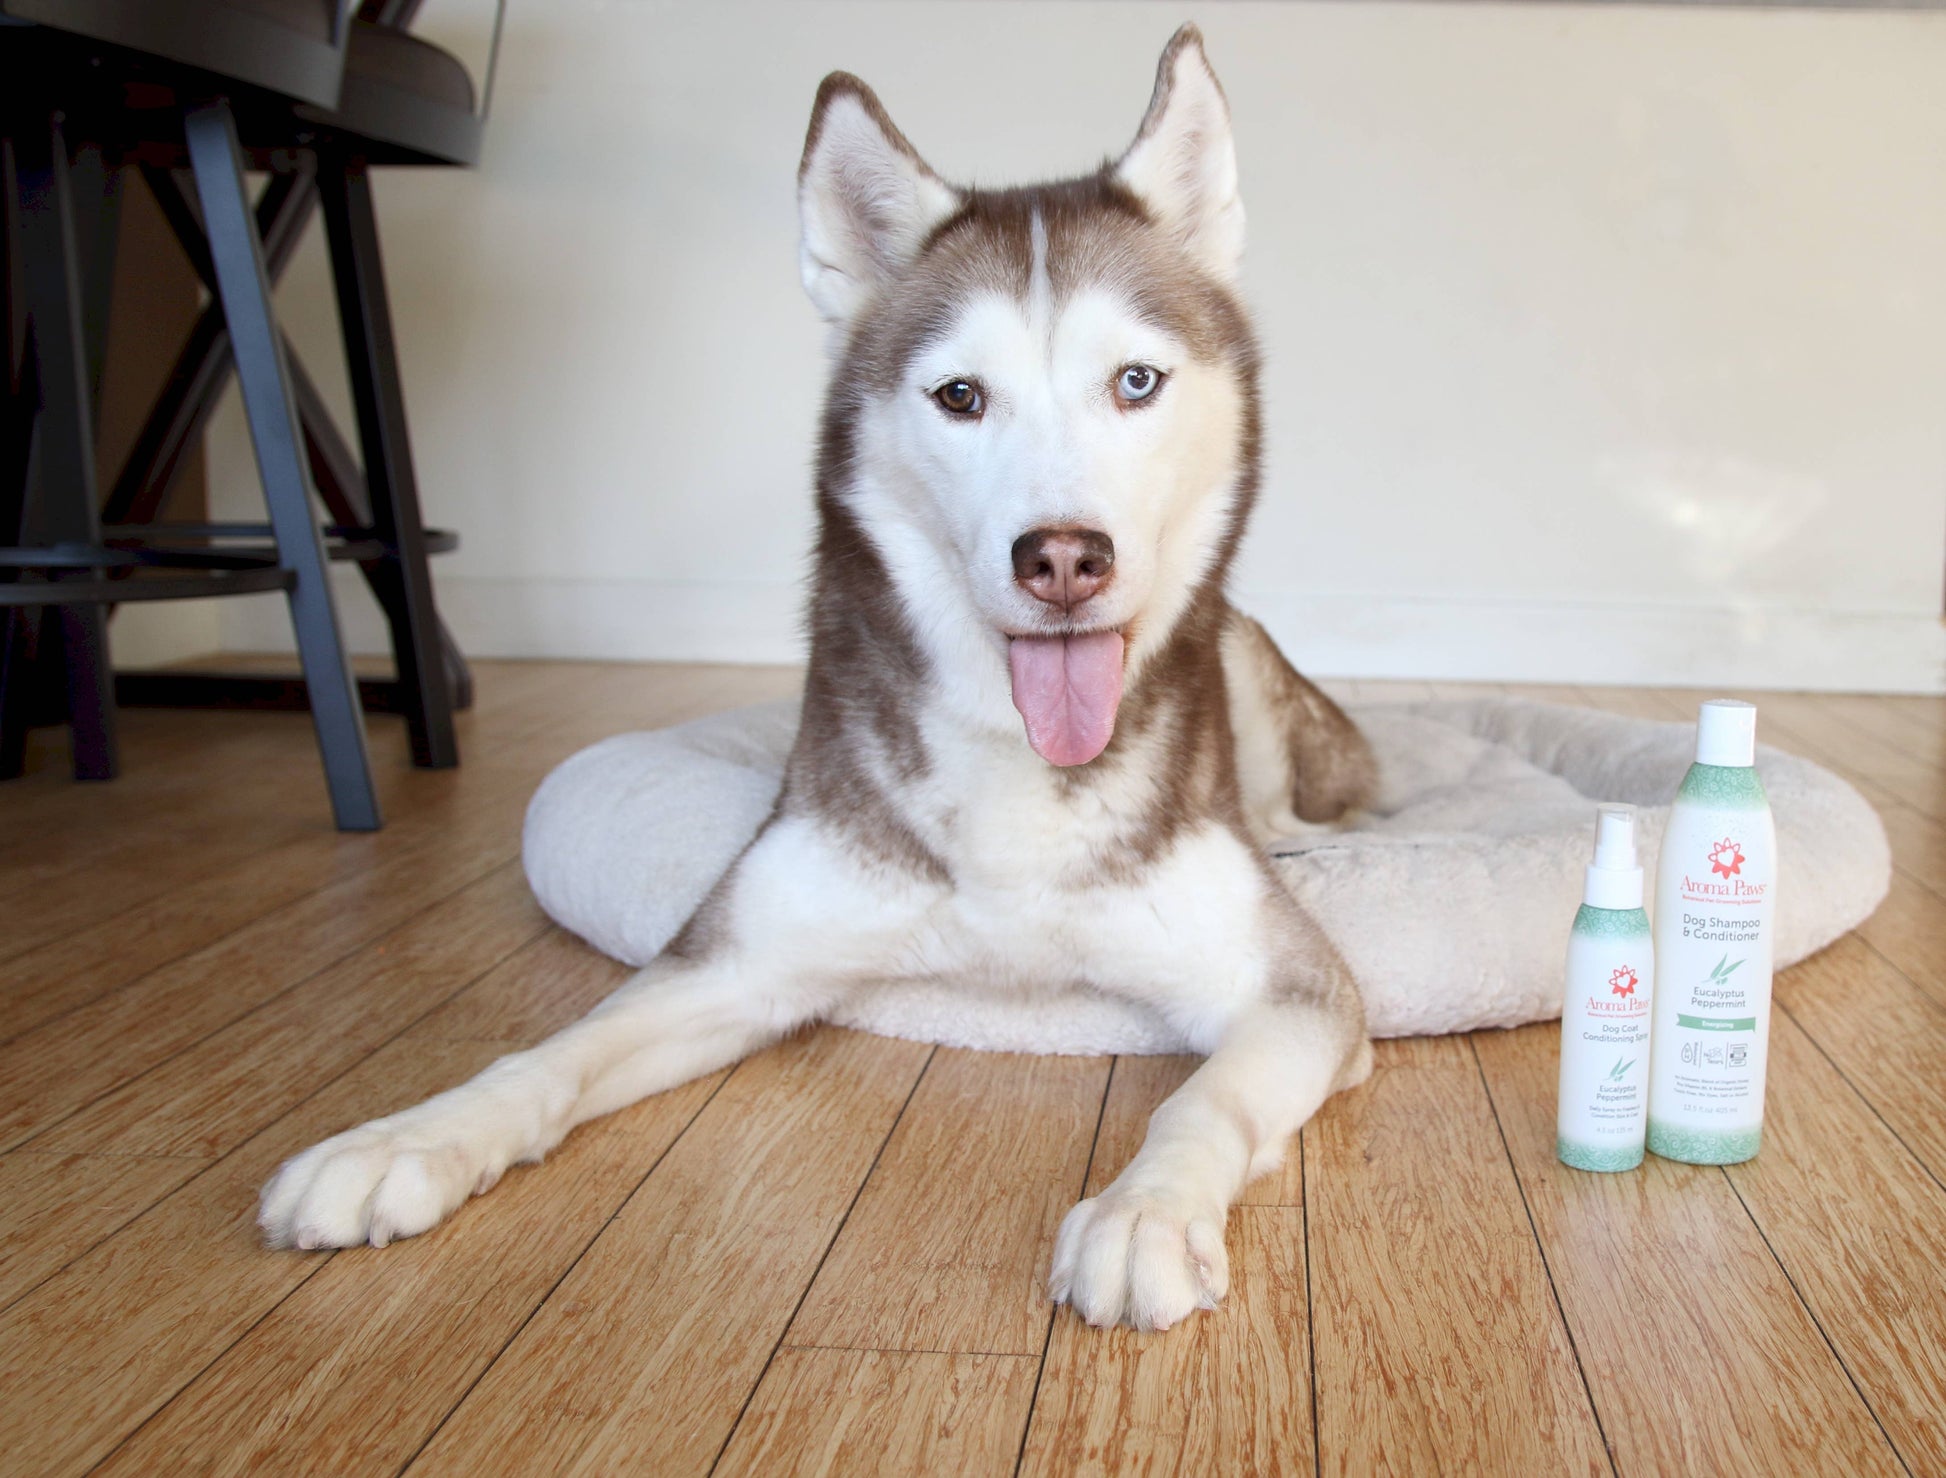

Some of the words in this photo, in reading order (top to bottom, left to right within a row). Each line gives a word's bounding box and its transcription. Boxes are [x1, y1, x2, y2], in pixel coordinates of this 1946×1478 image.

[1680, 875, 1729, 896] Aroma
[1734, 879, 1765, 897] Paws
[1683, 913, 1706, 928] Dog
[1709, 917, 1761, 930] Shampoo
[1683, 927, 1690, 937] &
[1693, 928, 1760, 942] Conditioner
[1693, 986, 1745, 999] Eucalyptus
[1585, 996, 1626, 1012] Aroma
[1691, 997, 1746, 1009] Peppermint
[1602, 1024, 1620, 1034] Dog
[1621, 1024, 1639, 1032] Coat
[1701, 1020, 1734, 1029] Energizing
[1582, 1032, 1634, 1043] Conditioning
[1599, 1085, 1637, 1095] Eucalyptus
[1596, 1093, 1637, 1102] Peppermint
